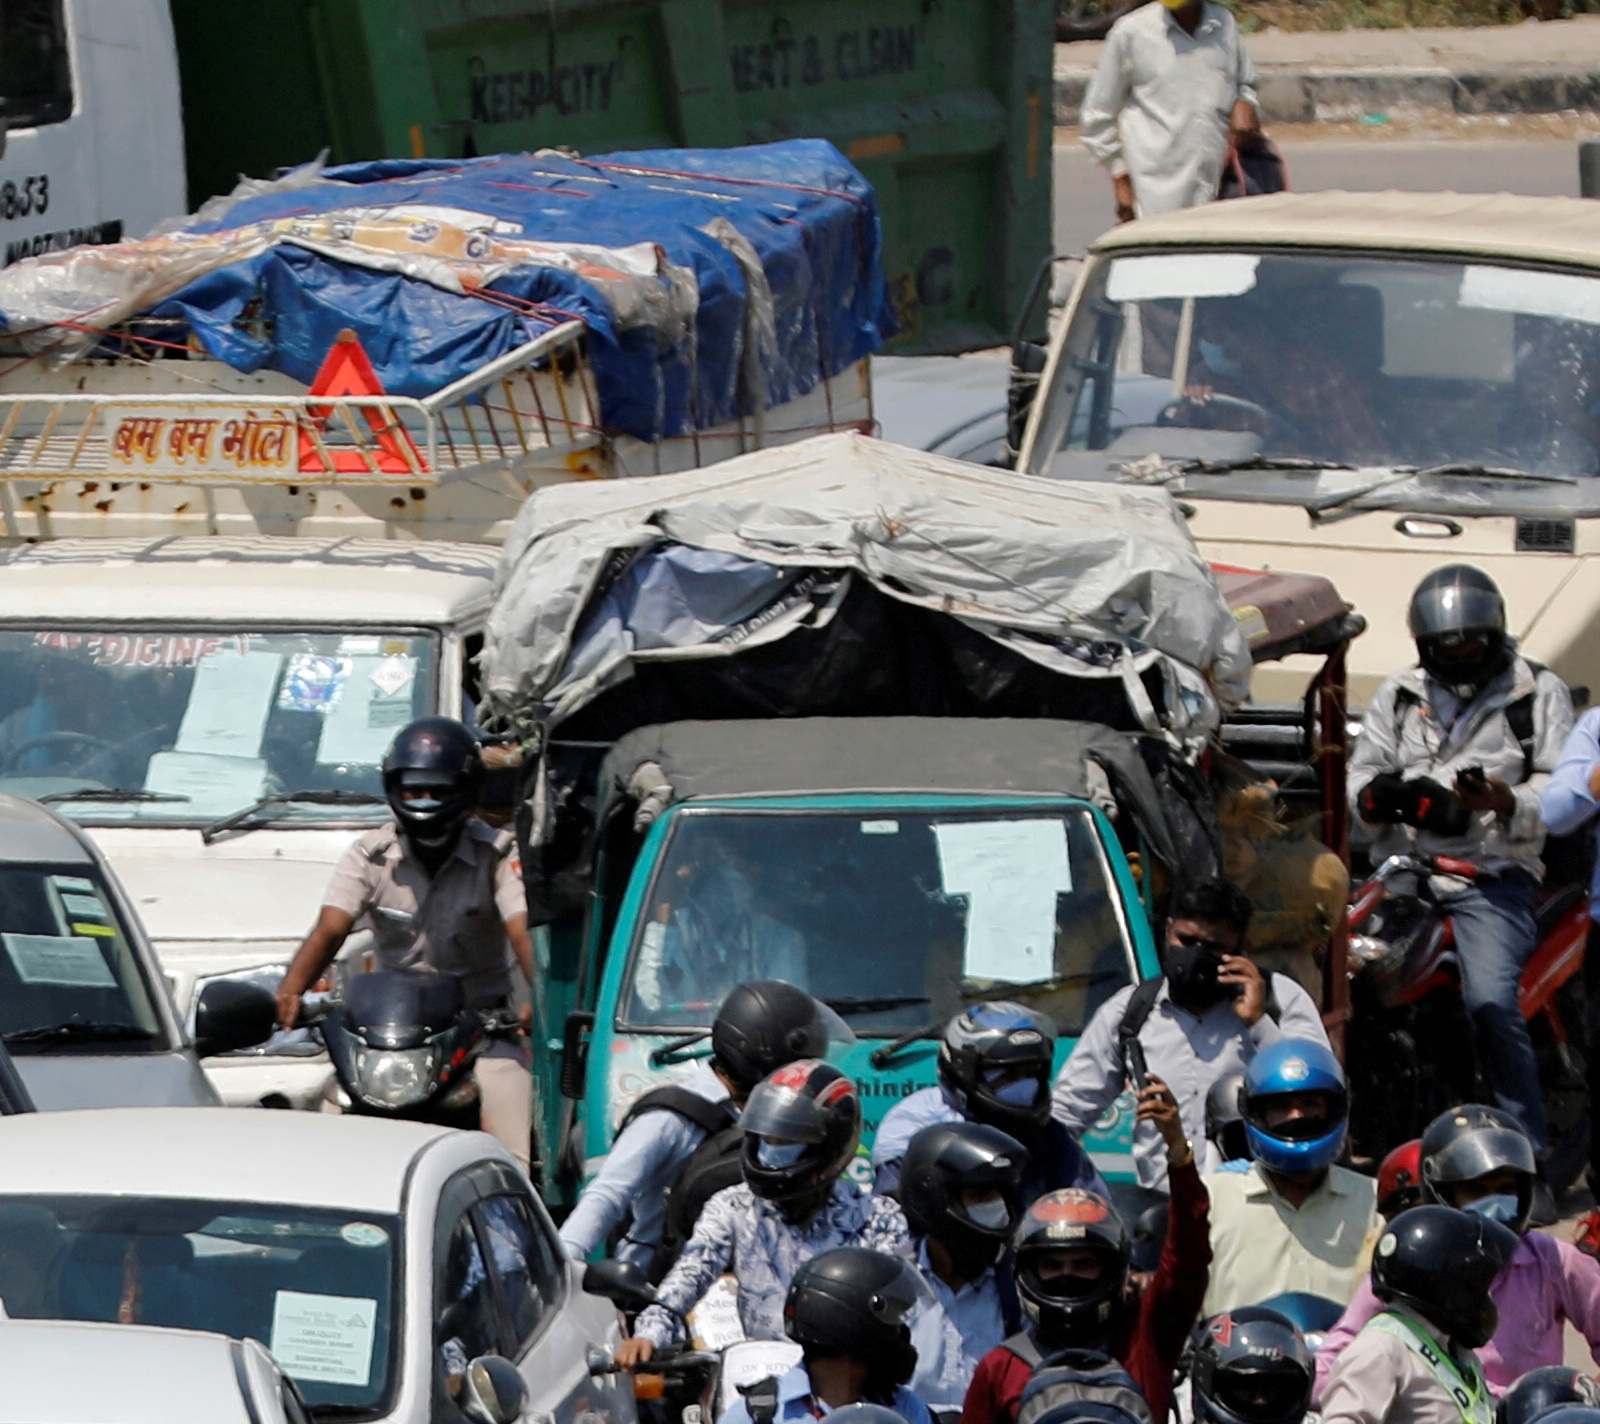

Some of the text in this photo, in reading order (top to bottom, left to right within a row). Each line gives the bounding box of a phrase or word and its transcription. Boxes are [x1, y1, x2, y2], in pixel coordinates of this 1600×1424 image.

[113, 409, 298, 467] बम बम भोले
